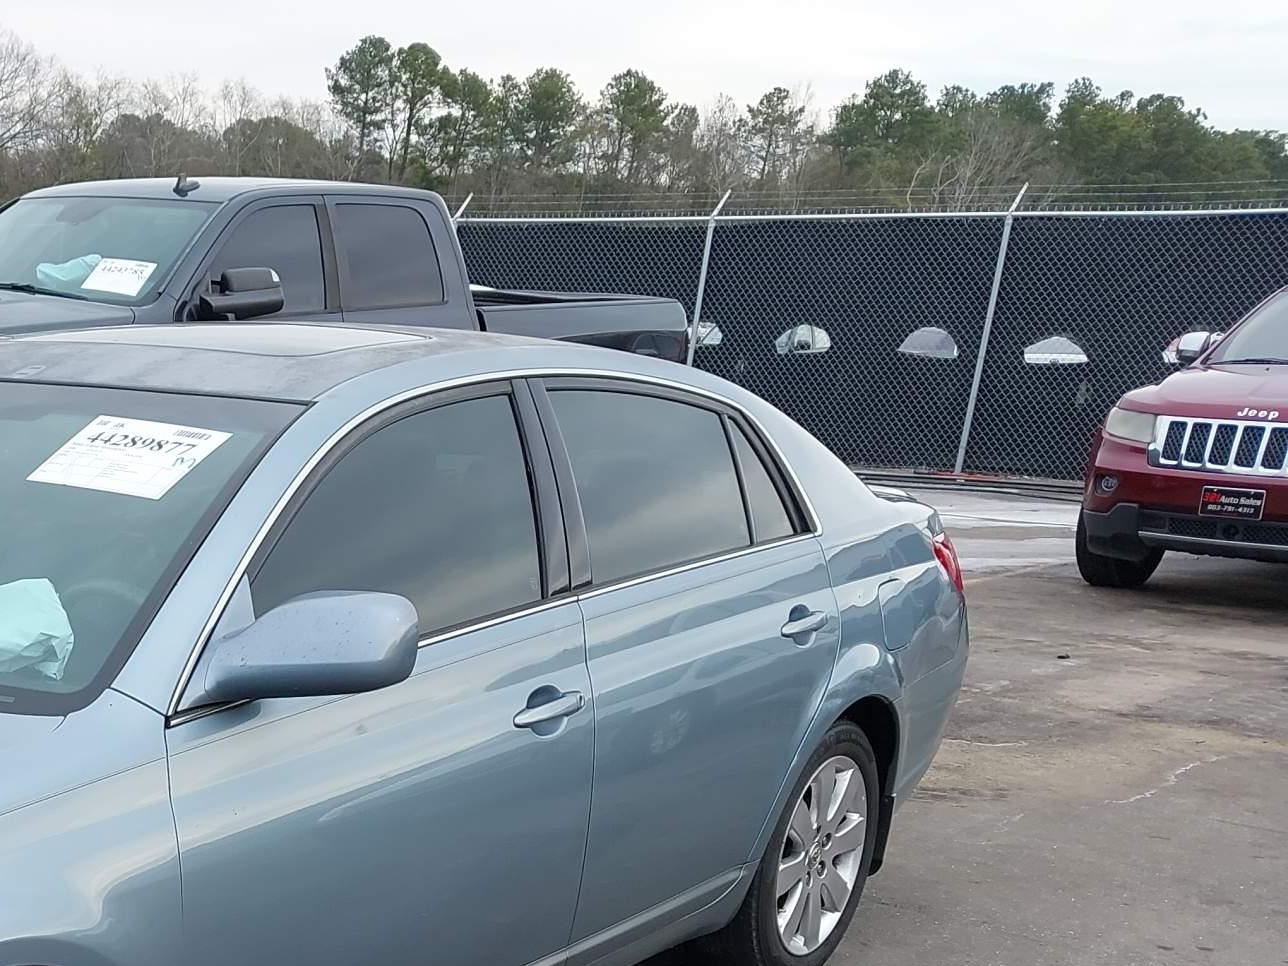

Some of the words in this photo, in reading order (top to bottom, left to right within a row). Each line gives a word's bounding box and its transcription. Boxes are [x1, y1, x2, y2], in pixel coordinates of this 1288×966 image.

[1237, 408, 1279, 420] Jeep
[87, 431, 197, 455] 44289877
[1219, 495, 1239, 504] Auto
[1239, 496, 1262, 505] Sales
